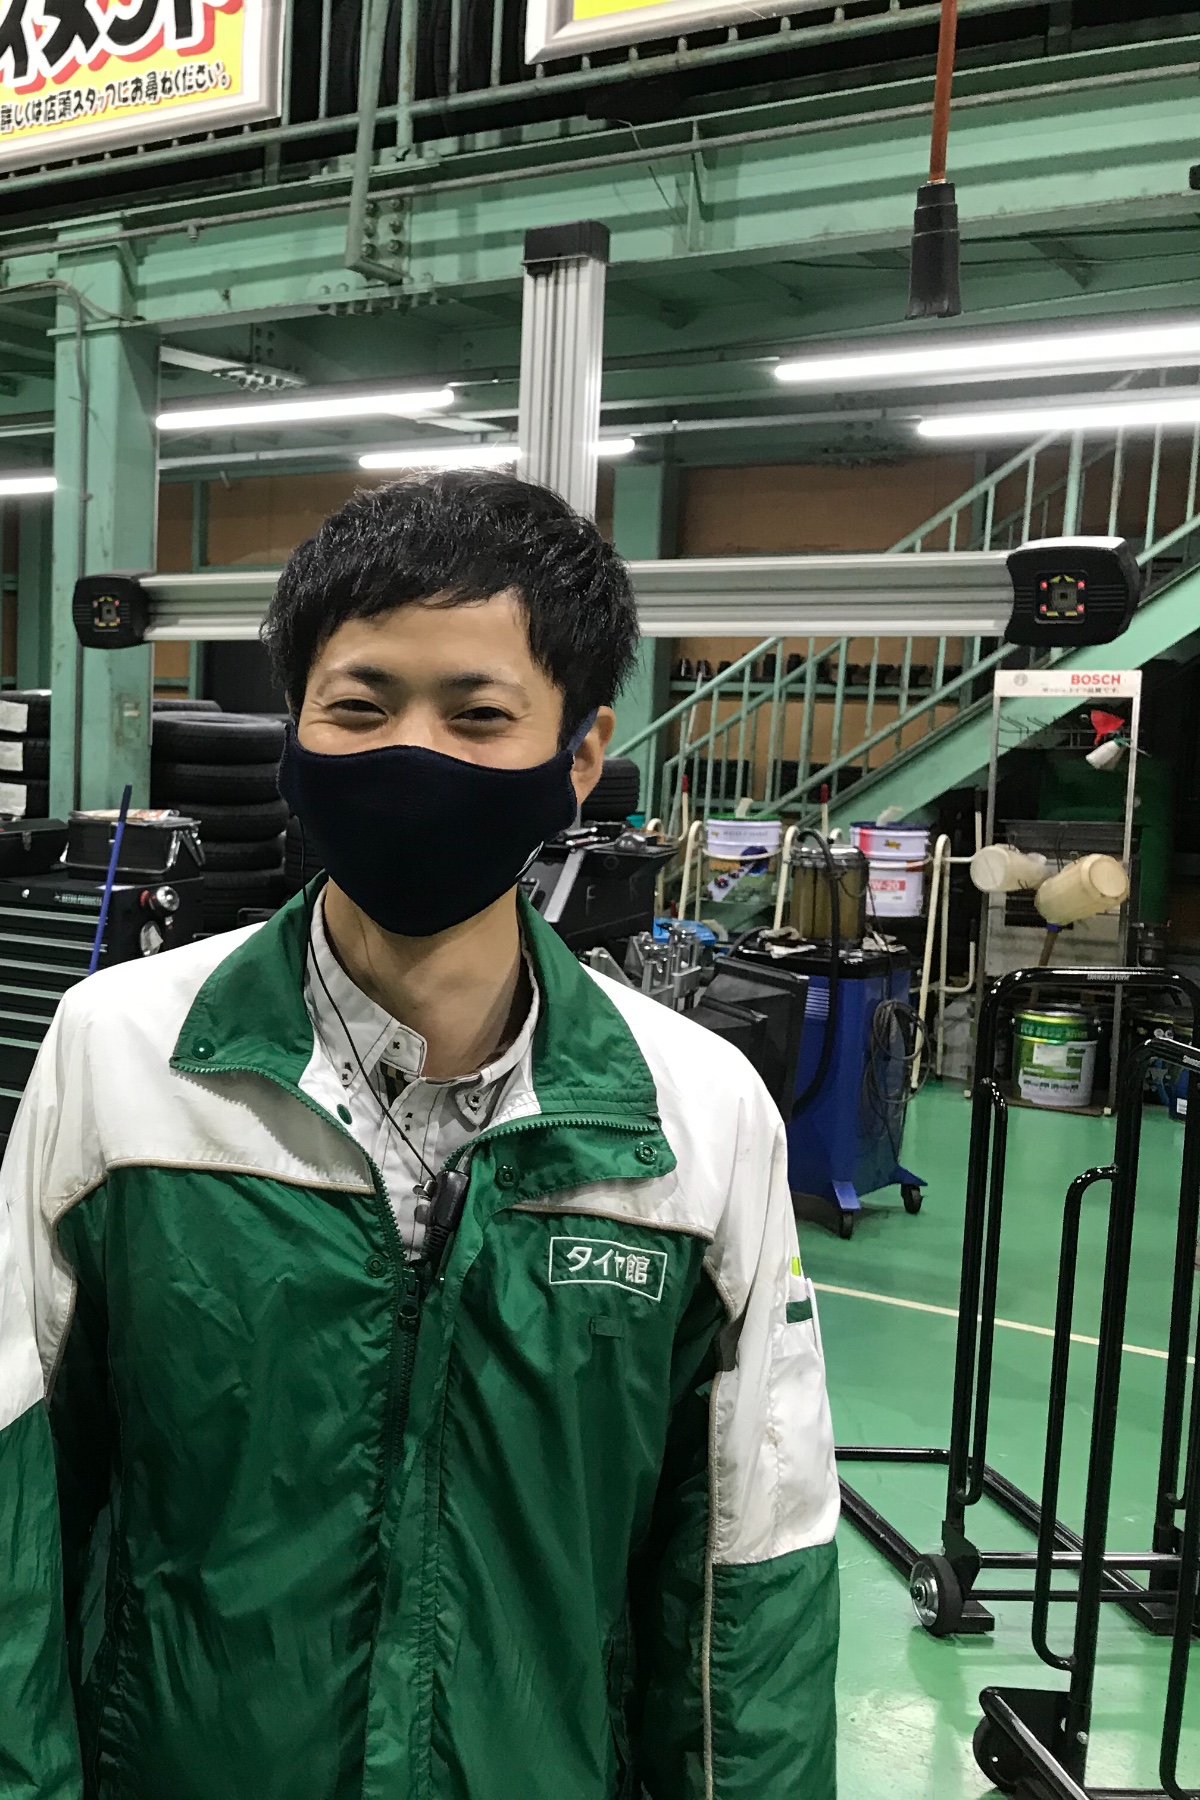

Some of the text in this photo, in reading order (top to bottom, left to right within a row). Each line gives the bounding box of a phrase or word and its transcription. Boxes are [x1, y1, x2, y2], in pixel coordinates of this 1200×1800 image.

[1071, 674, 1121, 685] BOSCH
[566, 1246, 651, 1285] タイヤ館
